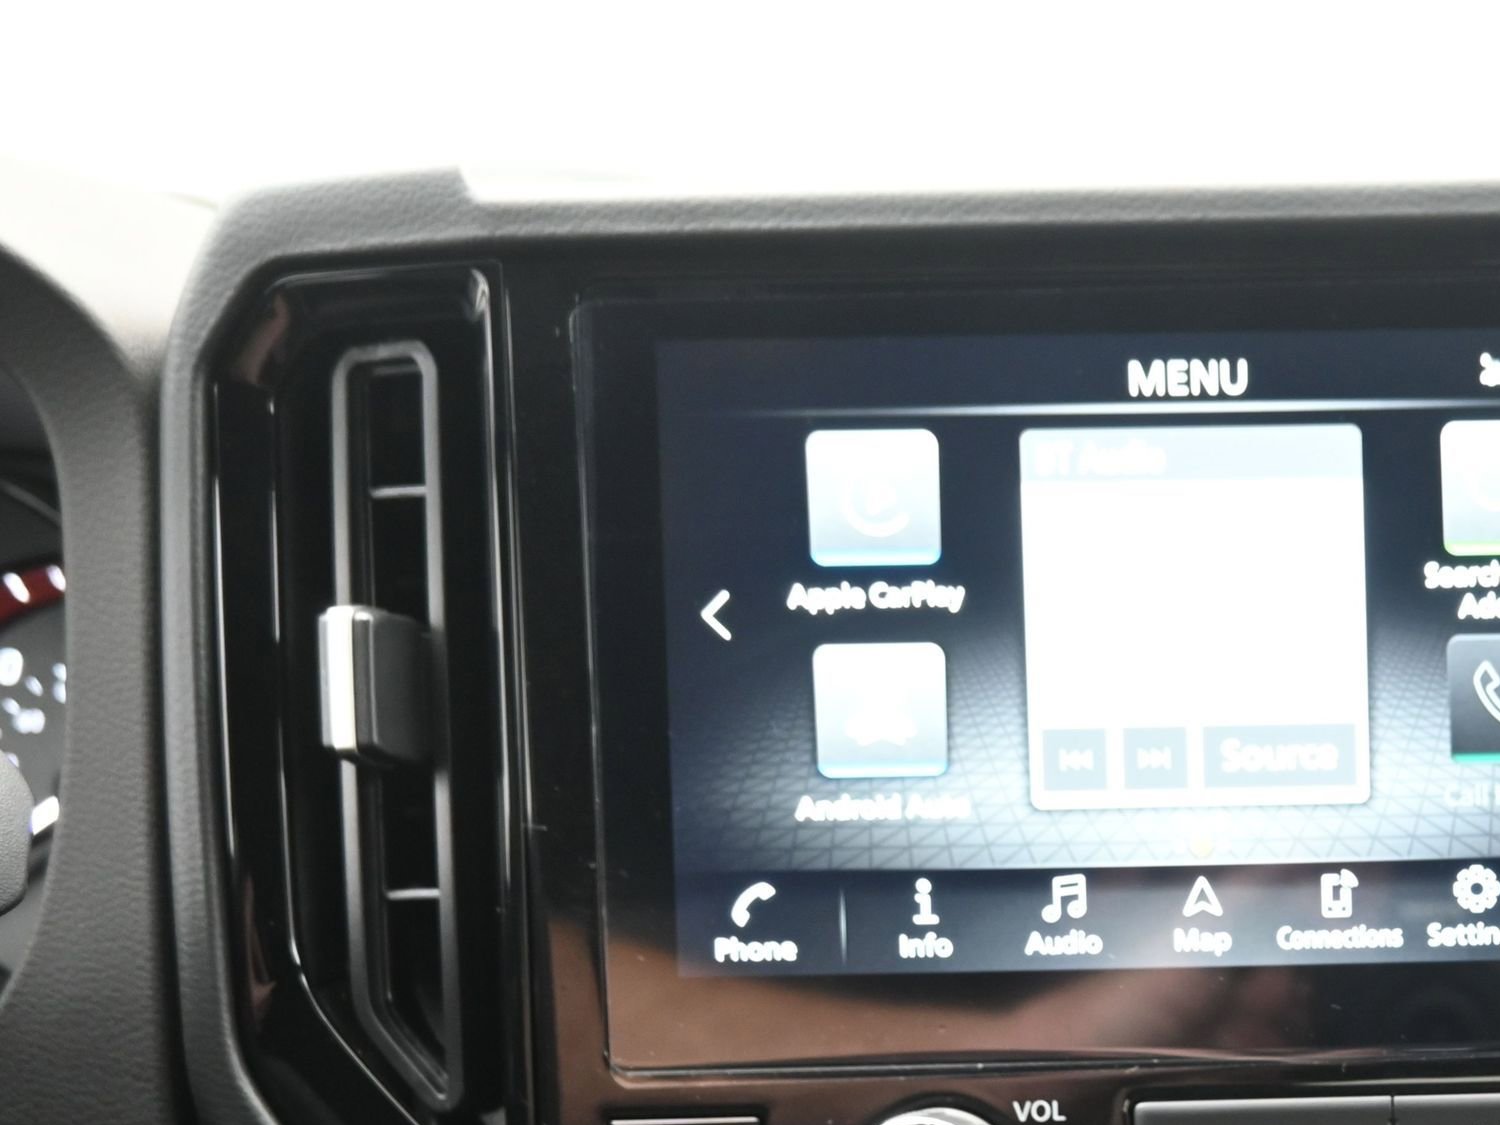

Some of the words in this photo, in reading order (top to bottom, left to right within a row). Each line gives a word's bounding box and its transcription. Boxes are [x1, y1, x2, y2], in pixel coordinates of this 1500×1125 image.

[1127, 358, 1248, 397] MENU
[786, 582, 867, 615] Apple
[868, 579, 965, 613] CarPlay
[1219, 738, 1338, 773] Source
[795, 794, 901, 822] Android
[1444, 782, 1489, 808] Call
[714, 936, 797, 962] Phone
[899, 931, 954, 959] Info
[1025, 929, 1104, 956] Audio
[1174, 927, 1232, 956] Map
[1276, 924, 1404, 951] Connections
[1013, 1100, 1067, 1122] VOL
